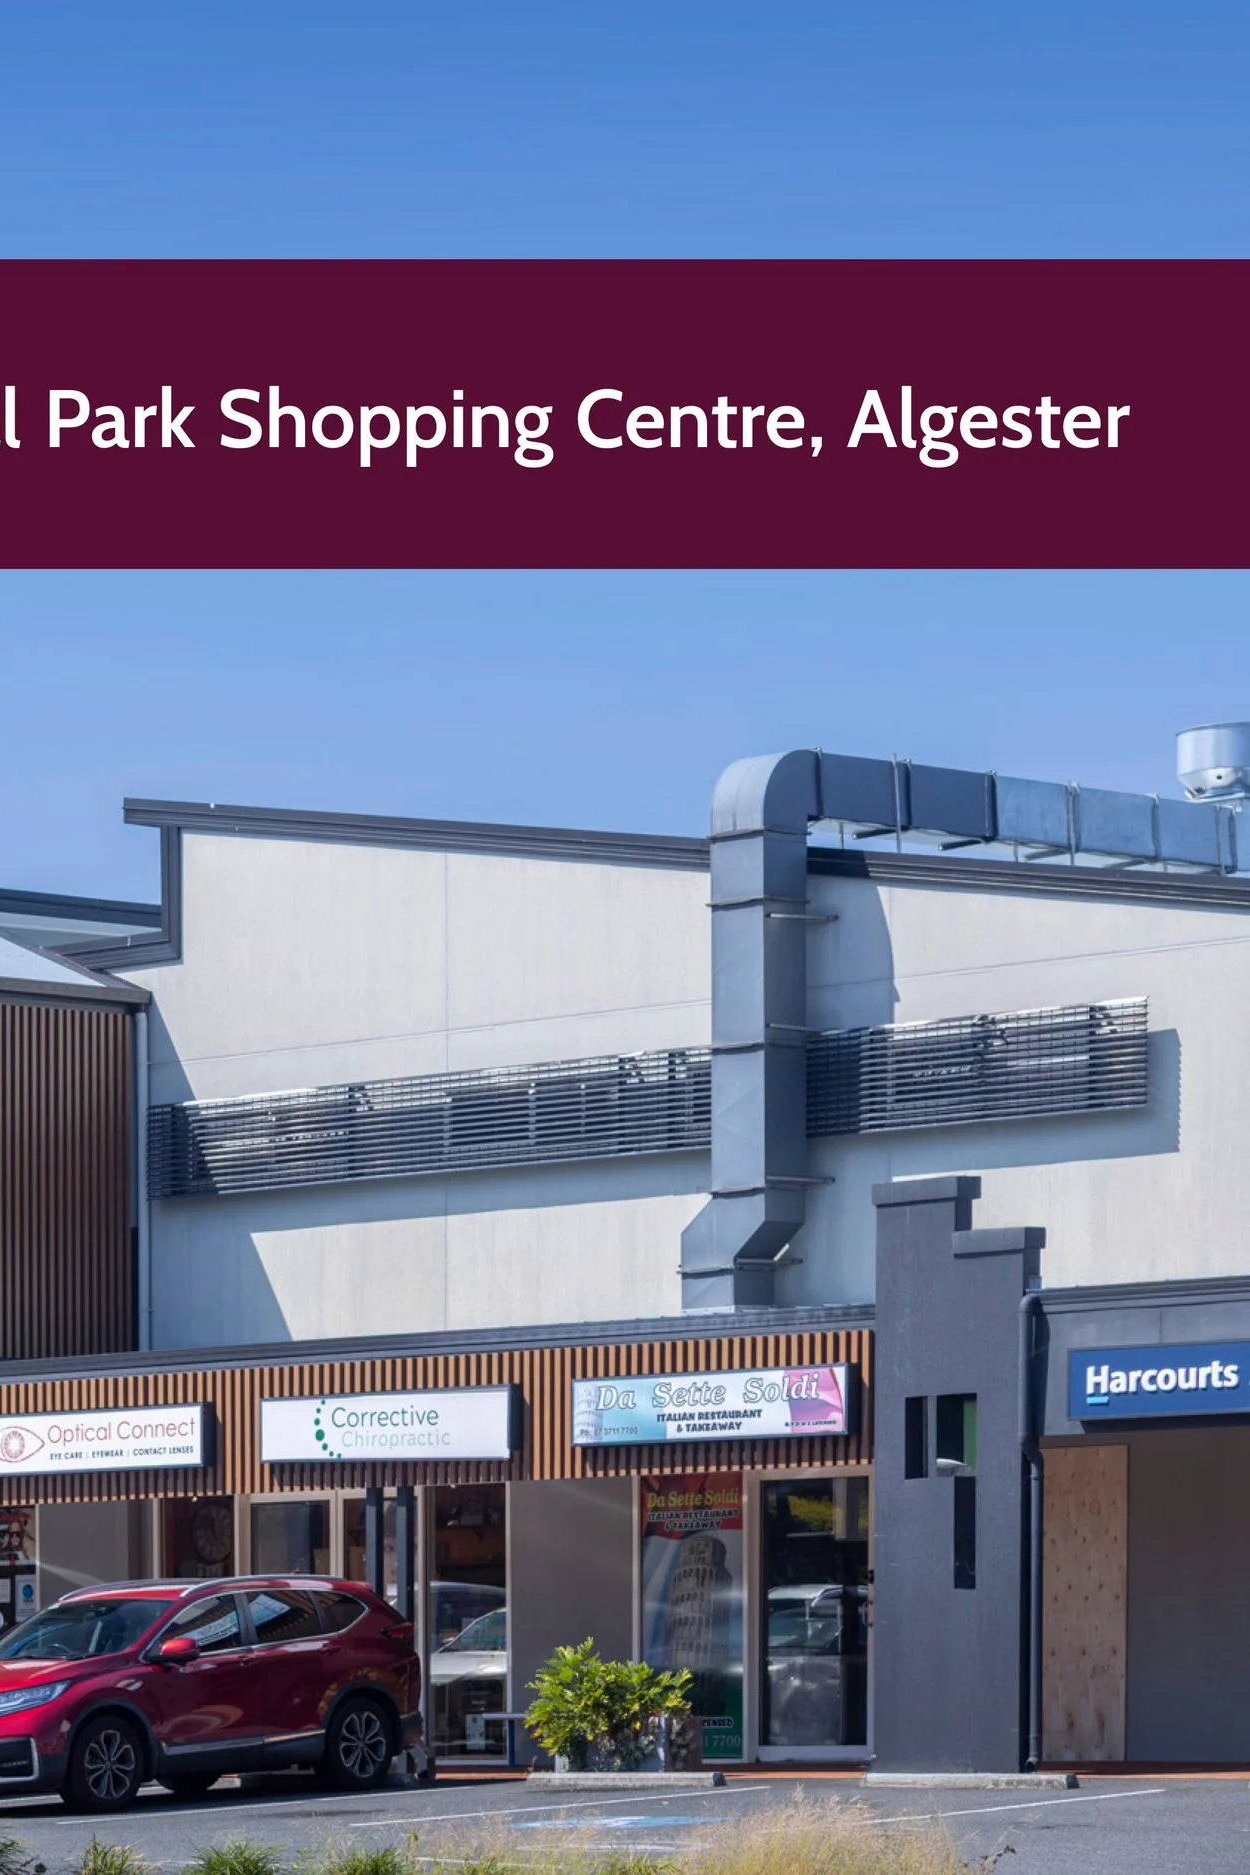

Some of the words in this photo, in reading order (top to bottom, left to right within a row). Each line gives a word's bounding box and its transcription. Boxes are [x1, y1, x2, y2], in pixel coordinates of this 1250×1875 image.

[1086, 1360, 1239, 1394] Harcourts
[596, 1385, 636, 1411] Da
[652, 1381, 727, 1408] Sette
[743, 1372, 821, 1404] Soldi
[331, 1405, 440, 1428] Corrective
[657, 1411, 695, 1422] ITALIAN
[697, 1409, 762, 1421] RESTAURANT
[47, 1422, 112, 1446] Optical
[116, 1417, 196, 1440] Connect
[684, 1421, 742, 1433] TAKEAWAY
[341, 1429, 450, 1449] Chiropractic
[50, 1452, 62, 1460] EYE
[64, 1451, 83, 1460] CARE
[92, 1449, 124, 1458] EYEWEAR
[133, 1447, 167, 1456] CONTACT
[170, 1445, 194, 1454] LENSES
